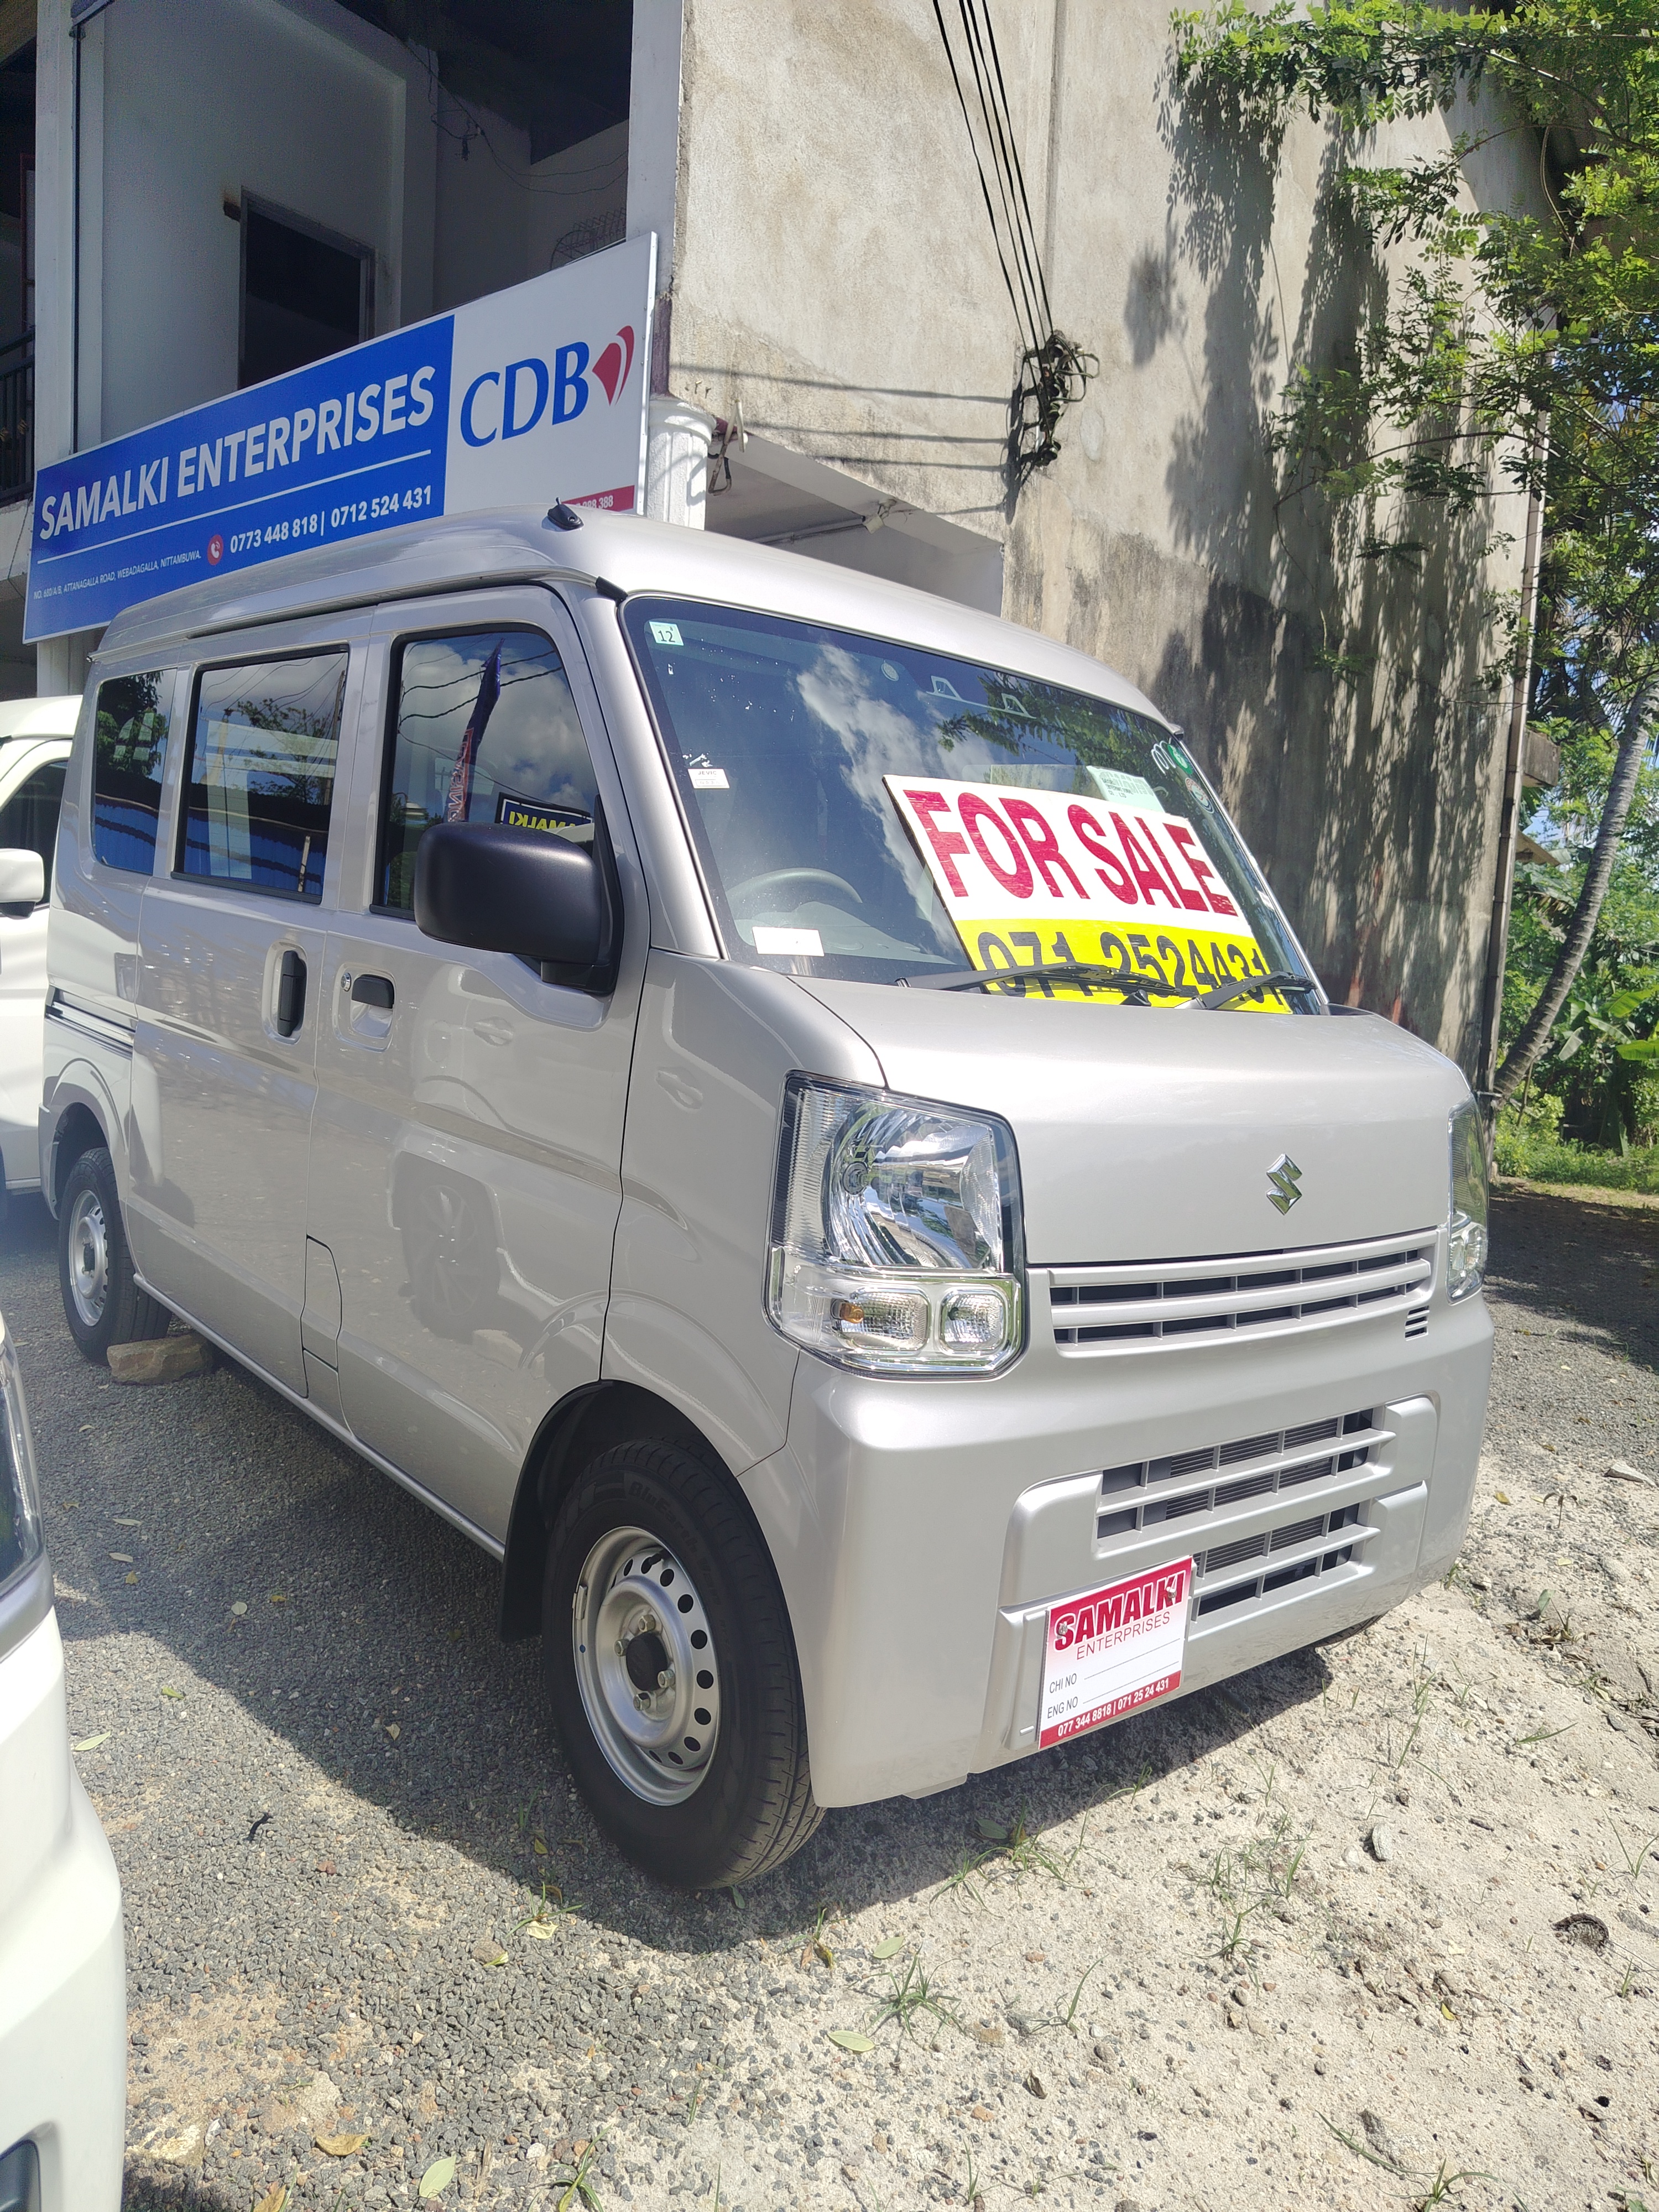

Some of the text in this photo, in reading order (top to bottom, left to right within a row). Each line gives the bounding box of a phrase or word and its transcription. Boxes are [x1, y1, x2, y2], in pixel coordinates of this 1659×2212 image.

[460, 341, 589, 447] CDB
[40, 365, 436, 540] SAMALKI ENTERPRISES
[230, 529, 262, 553] 0773
[264, 521, 289, 544] 448
[292, 514, 317, 538] 818
[331, 502, 367, 528] 0712
[371, 493, 399, 518] 524
[403, 485, 431, 509] 431
[599, 495, 613, 509] 388
[64, 578, 99, 592] ATTANAGALLA
[658, 630, 676, 643] 12
[903, 790, 1239, 917] FOR SALE
[977, 932, 1094, 998] 071
[1055, 1571, 1185, 1651] SAMALKI
[1076, 1611, 1170, 1660] ENTERPRISES
[1047, 1696, 1078, 1719] ENG NO
[1050, 1673, 1077, 1693] CHI NO
[1057, 1721, 1073, 1736] 077
[1075, 1713, 1091, 1729] 344
[1092, 1703, 1112, 1721] 8818
[1118, 1694, 1132, 1710] 071
[1133, 1689, 1144, 1703] 25
[1144, 1684, 1154, 1698] 24
[1155, 1677, 1169, 1693] 431
